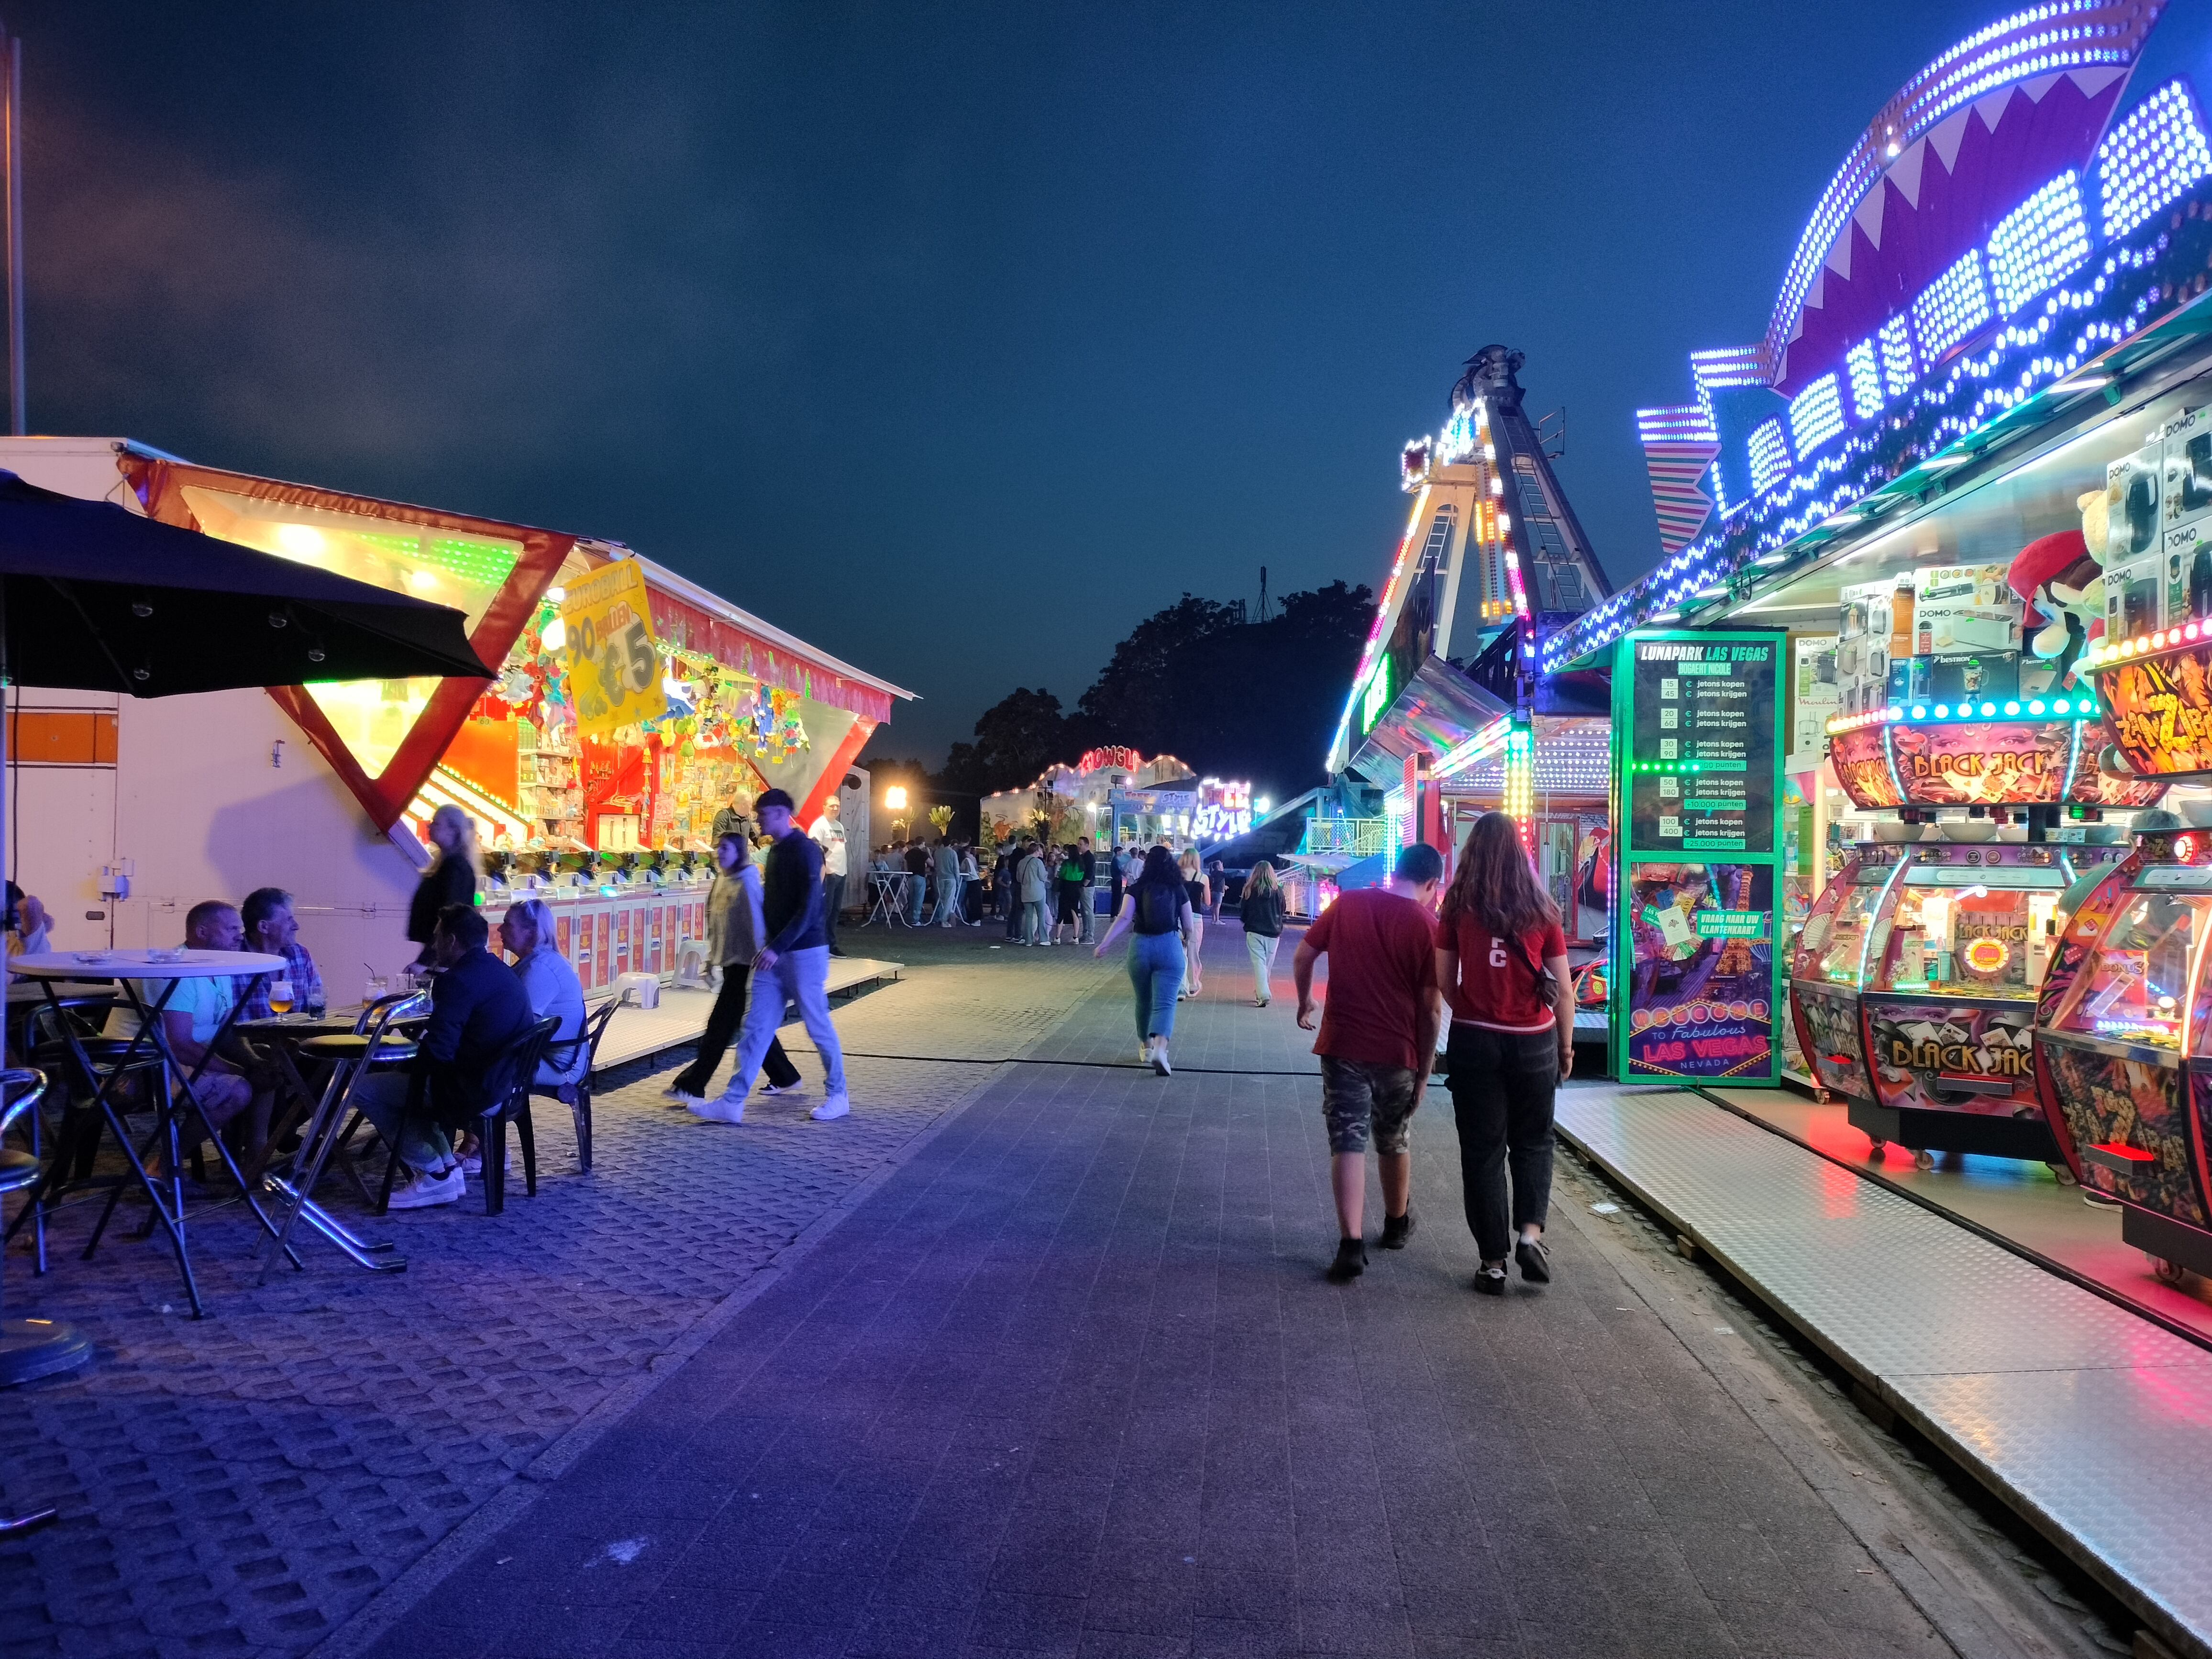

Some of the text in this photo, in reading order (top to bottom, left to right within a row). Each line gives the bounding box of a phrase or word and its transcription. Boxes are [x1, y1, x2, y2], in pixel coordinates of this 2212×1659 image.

[2166, 414, 2196, 438] DOMO
[2109, 462, 2131, 479] DOMO
[2108, 569, 2132, 586] DOMO
[564, 564, 638, 616] EUROBALL
[1919, 609, 1951, 618] DOMO
[566, 616, 596, 668] 90
[1640, 646, 1769, 661] LUNAPARK LAS VEGAS
[1679, 663, 1731, 674] BOGAERT NICOLE
[1697, 680, 1720, 688] jetons
[1722, 680, 1745, 688] kopen
[1696, 690, 1720, 698] jetons
[1722, 690, 1747, 698] krijgen
[1798, 697, 1837, 705] Moulin
[1696, 709, 1720, 718] jetons
[1721, 710, 1745, 718] kopen
[1696, 719, 1720, 728] jetons
[1721, 719, 1747, 728] krijgen
[1696, 740, 1719, 749] jetons
[1721, 741, 1744, 749] kopen
[1696, 750, 1719, 758] jetons
[1721, 750, 1746, 759] krijgen
[1080, 745, 1139, 778] MOWGLI
[1914, 752, 2046, 776] BLACK JACK
[1695, 778, 1719, 787] jetons
[1720, 779, 1743, 787] kopen
[1161, 792, 1191, 804] STYLE
[1695, 788, 1719, 796] jetons
[1720, 788, 1746, 797] krijgen
[1695, 818, 1718, 826] jetons
[1720, 818, 1743, 826] kopen
[1695, 829, 1718, 837] jetons
[1719, 829, 1745, 838] krijgen
[667, 910, 674, 926] 30
[696, 907, 702, 922] 30
[1701, 915, 1759, 924] VRAAG NAAR UW
[598, 918, 607, 935] 30
[634, 914, 642, 930] 30
[558, 921, 567, 941] 30
[1701, 926, 1756, 935] KLANTENKAART
[560, 944, 568, 957] alls
[597, 939, 608, 951] Balls
[2101, 961, 2144, 974] BONUS
[1635, 1003, 1764, 1024] WELCOME
[1671, 1025, 1746, 1040] Fabulous
[1644, 1036, 1768, 1062] LAS VEGAS
[1680, 1058, 1730, 1069] NEVADA
[1892, 1040, 2034, 1075] BLACK JAC
